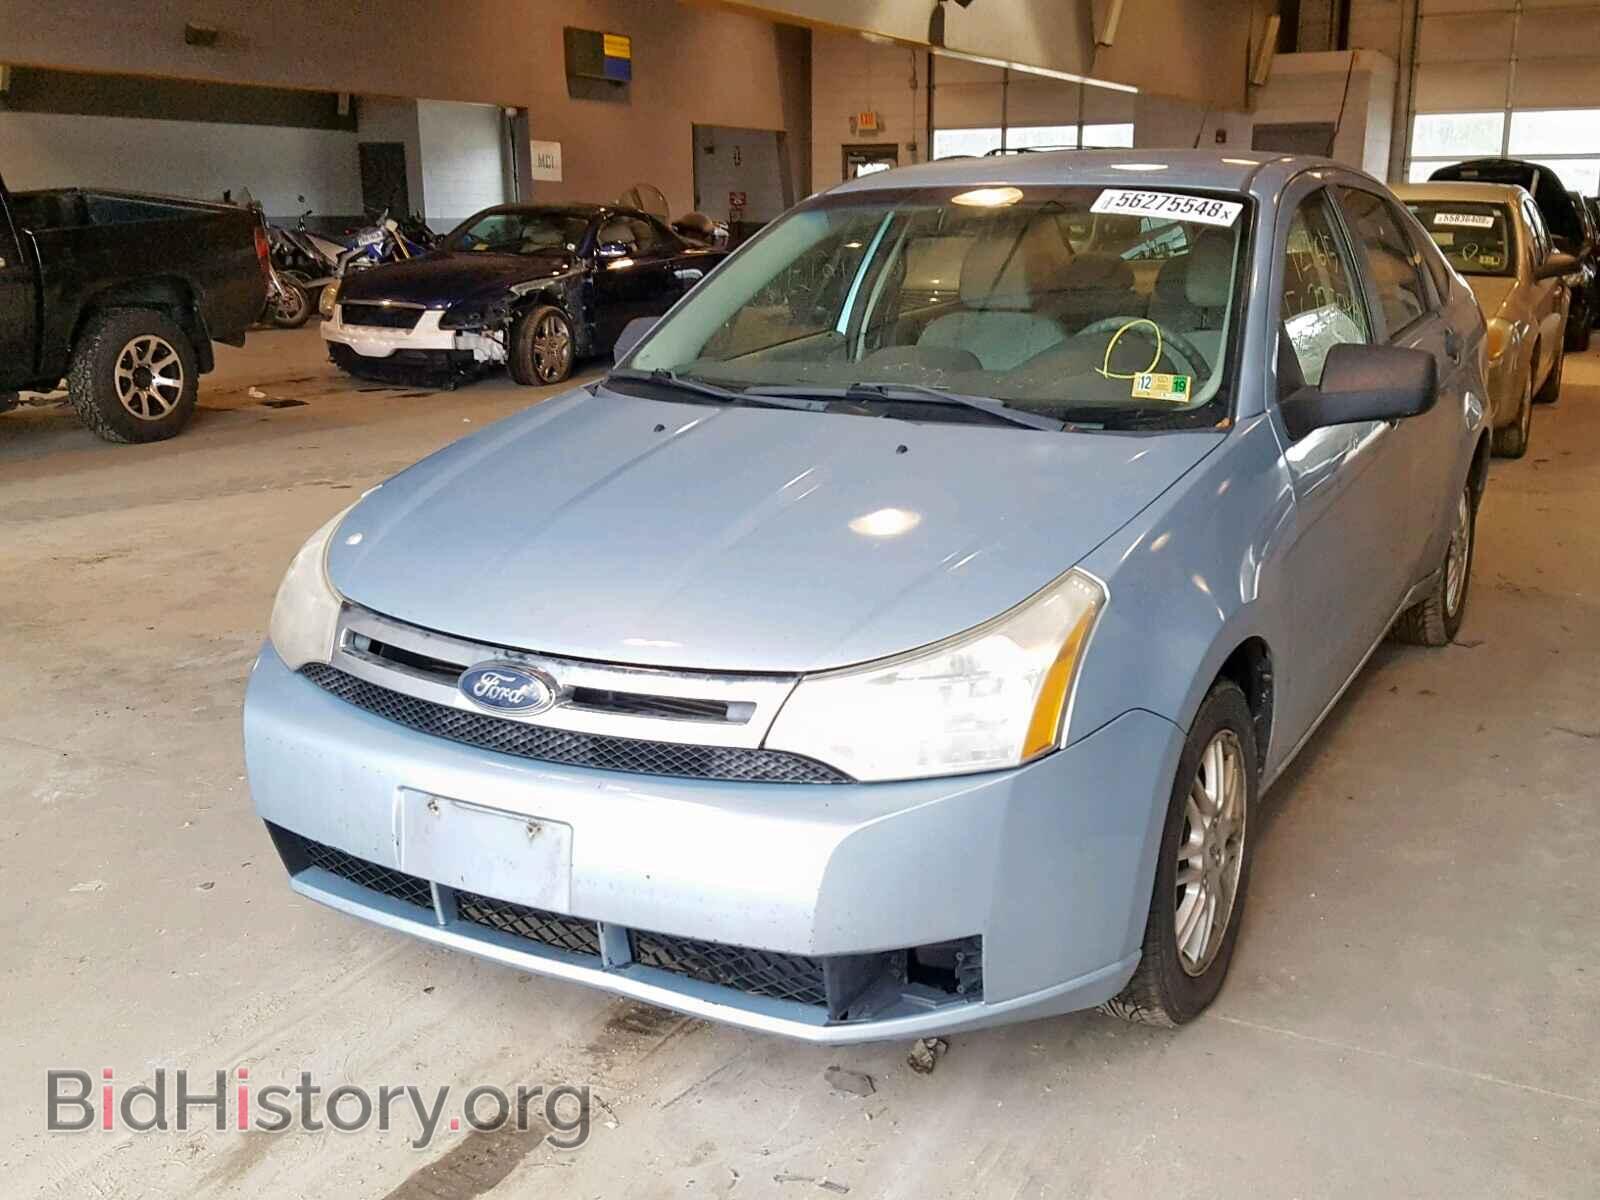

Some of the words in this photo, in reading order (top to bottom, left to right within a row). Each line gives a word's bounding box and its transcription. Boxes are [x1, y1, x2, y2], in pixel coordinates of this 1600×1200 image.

[1115, 192, 1224, 218] 56275548
[1140, 375, 1152, 389] 12
[1173, 380, 1186, 393] 19
[474, 672, 531, 703] Ford
